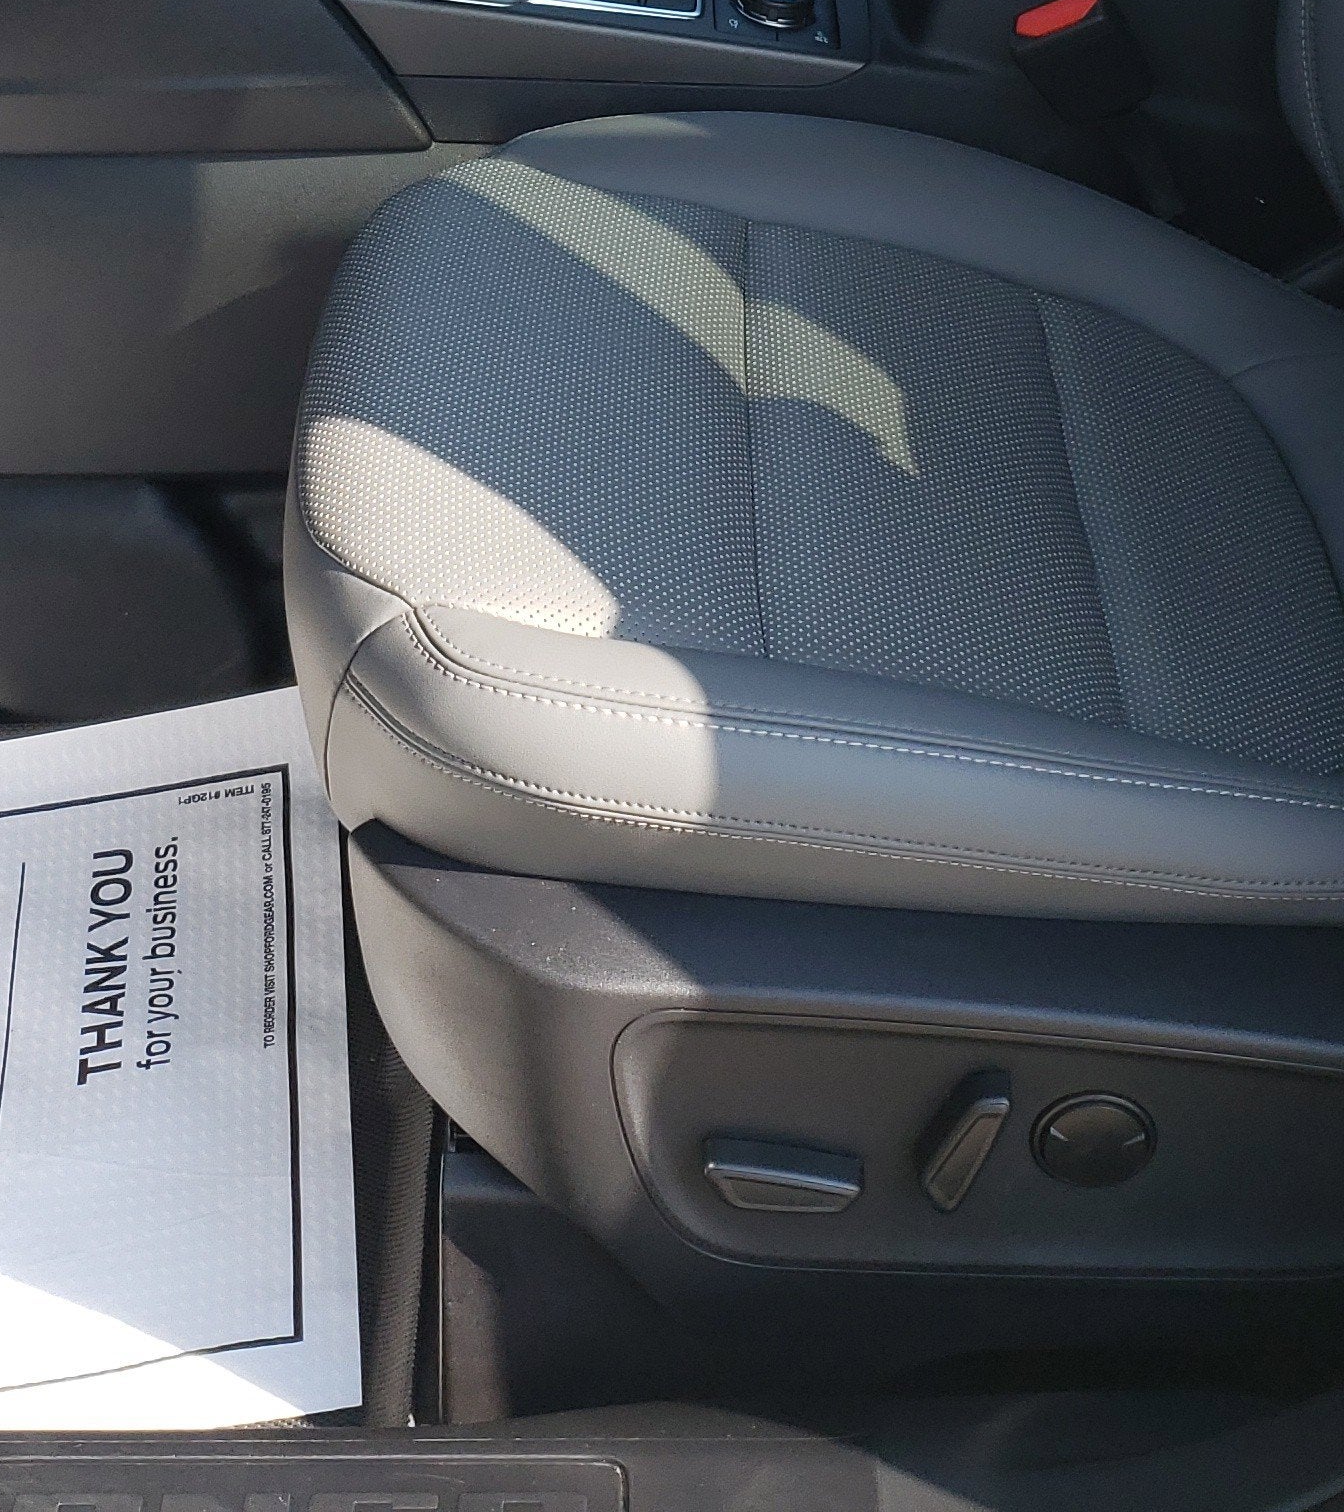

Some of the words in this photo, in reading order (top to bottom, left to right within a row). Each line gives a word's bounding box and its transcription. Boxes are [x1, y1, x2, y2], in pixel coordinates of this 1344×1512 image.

[178, 790, 221, 806] #12GP1
[224, 784, 255, 798] ITEM
[261, 835, 273, 862] CALL
[266, 863, 273, 874] or
[87, 848, 134, 933] YOU
[142, 836, 179, 961] business.
[262, 874, 276, 973] SHOPFORDGEAR.COM
[147, 967, 180, 1020] your
[263, 973, 276, 996] VISIT
[77, 936, 129, 1086] THANK
[263, 995, 276, 1034] REORDER
[136, 1030, 172, 1070] for
[263, 1034, 276, 1049] TO
